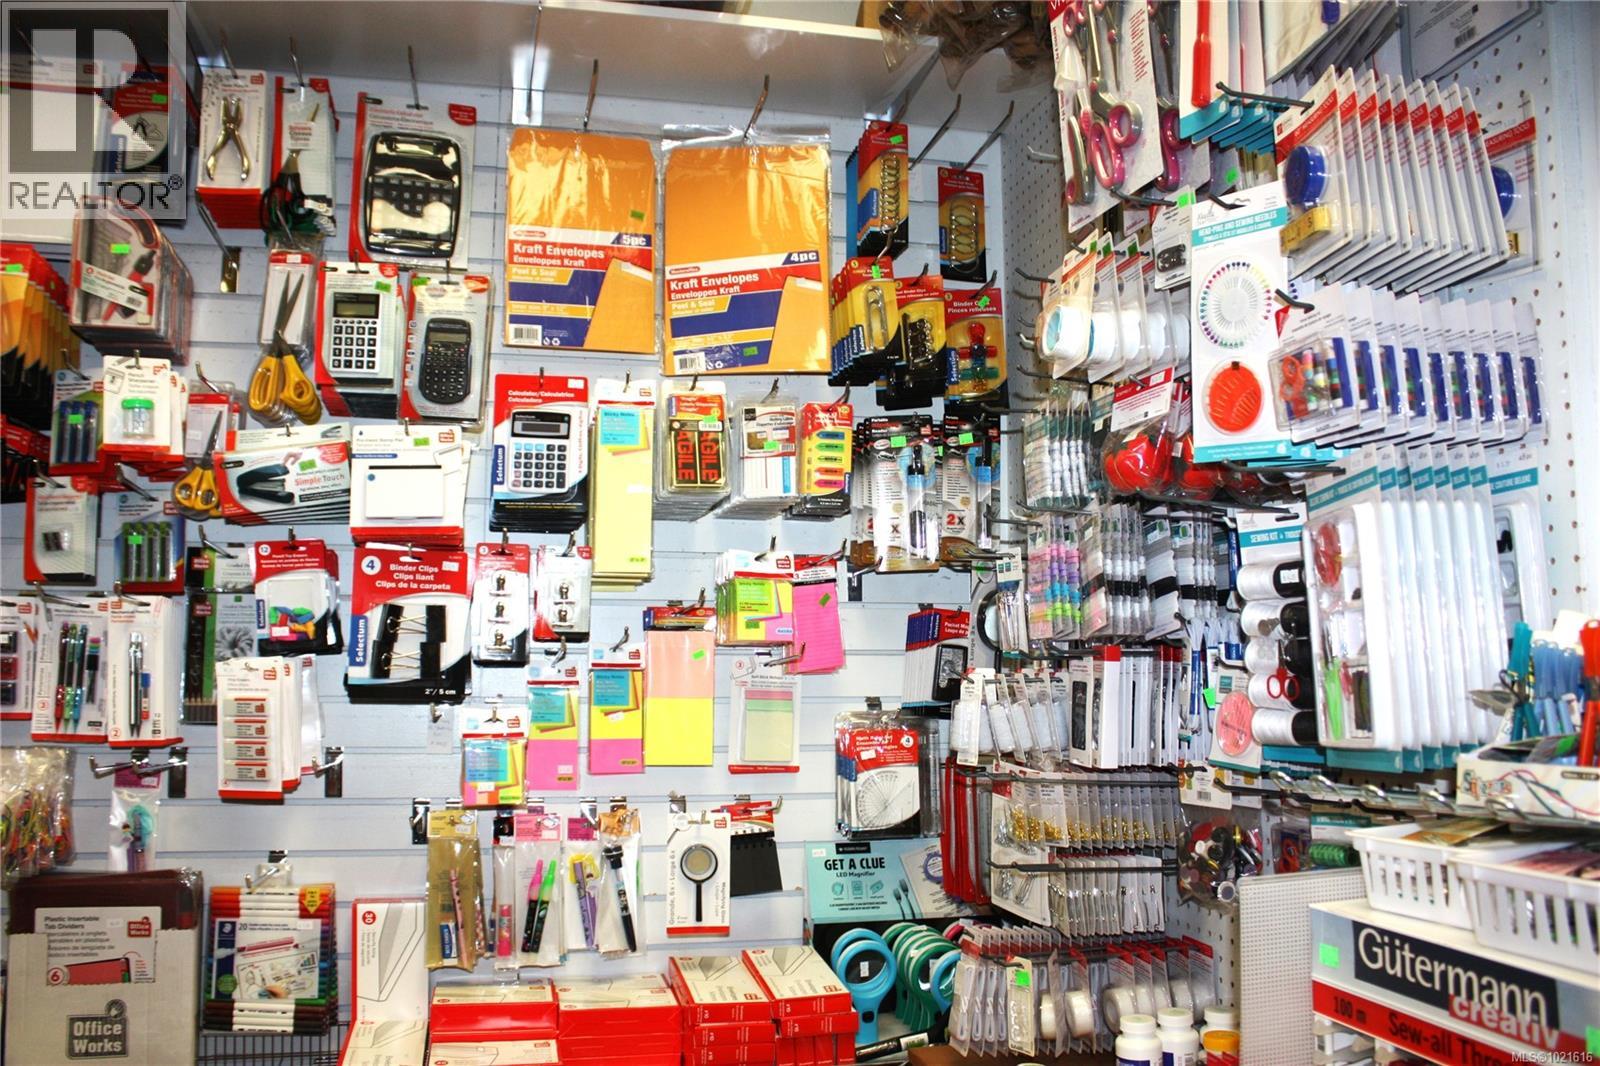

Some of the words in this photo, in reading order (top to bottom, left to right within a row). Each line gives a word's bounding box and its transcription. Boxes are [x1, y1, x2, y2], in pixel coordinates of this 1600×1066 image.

[622, 234, 647, 247] 5pc
[513, 243, 543, 255] Kraft
[546, 246, 605, 260] Envelopes
[790, 251, 818, 263] 4pc
[513, 255, 561, 267] Enveloppes
[563, 259, 585, 267] Kraft
[670, 279, 699, 291] Kraft
[702, 273, 759, 288] Envelopes
[671, 287, 717, 301] Enveloppes
[720, 285, 741, 295] Kraft
[496, 447, 504, 482] Selectum
[294, 477, 322, 486] Simple
[323, 474, 345, 483] Touch
[366, 559, 376, 571] 4
[390, 564, 416, 572] Binder
[418, 565, 438, 573] Clips
[415, 573, 434, 581] liant
[376, 581, 396, 589] Clips
[419, 583, 451, 591] carpeta
[355, 620, 366, 663] Selectum
[824, 858, 845, 871] GET
[848, 858, 857, 870] A
[860, 857, 886, 870] CLUE
[50, 971, 60, 982] 6
[1358, 927, 1550, 1029] Gütermann
[73, 1020, 122, 1037] Office
[1451, 996, 1561, 1049] creativ
[1388, 1012, 1453, 1058] Sew-all
[73, 1038, 122, 1054] Works
